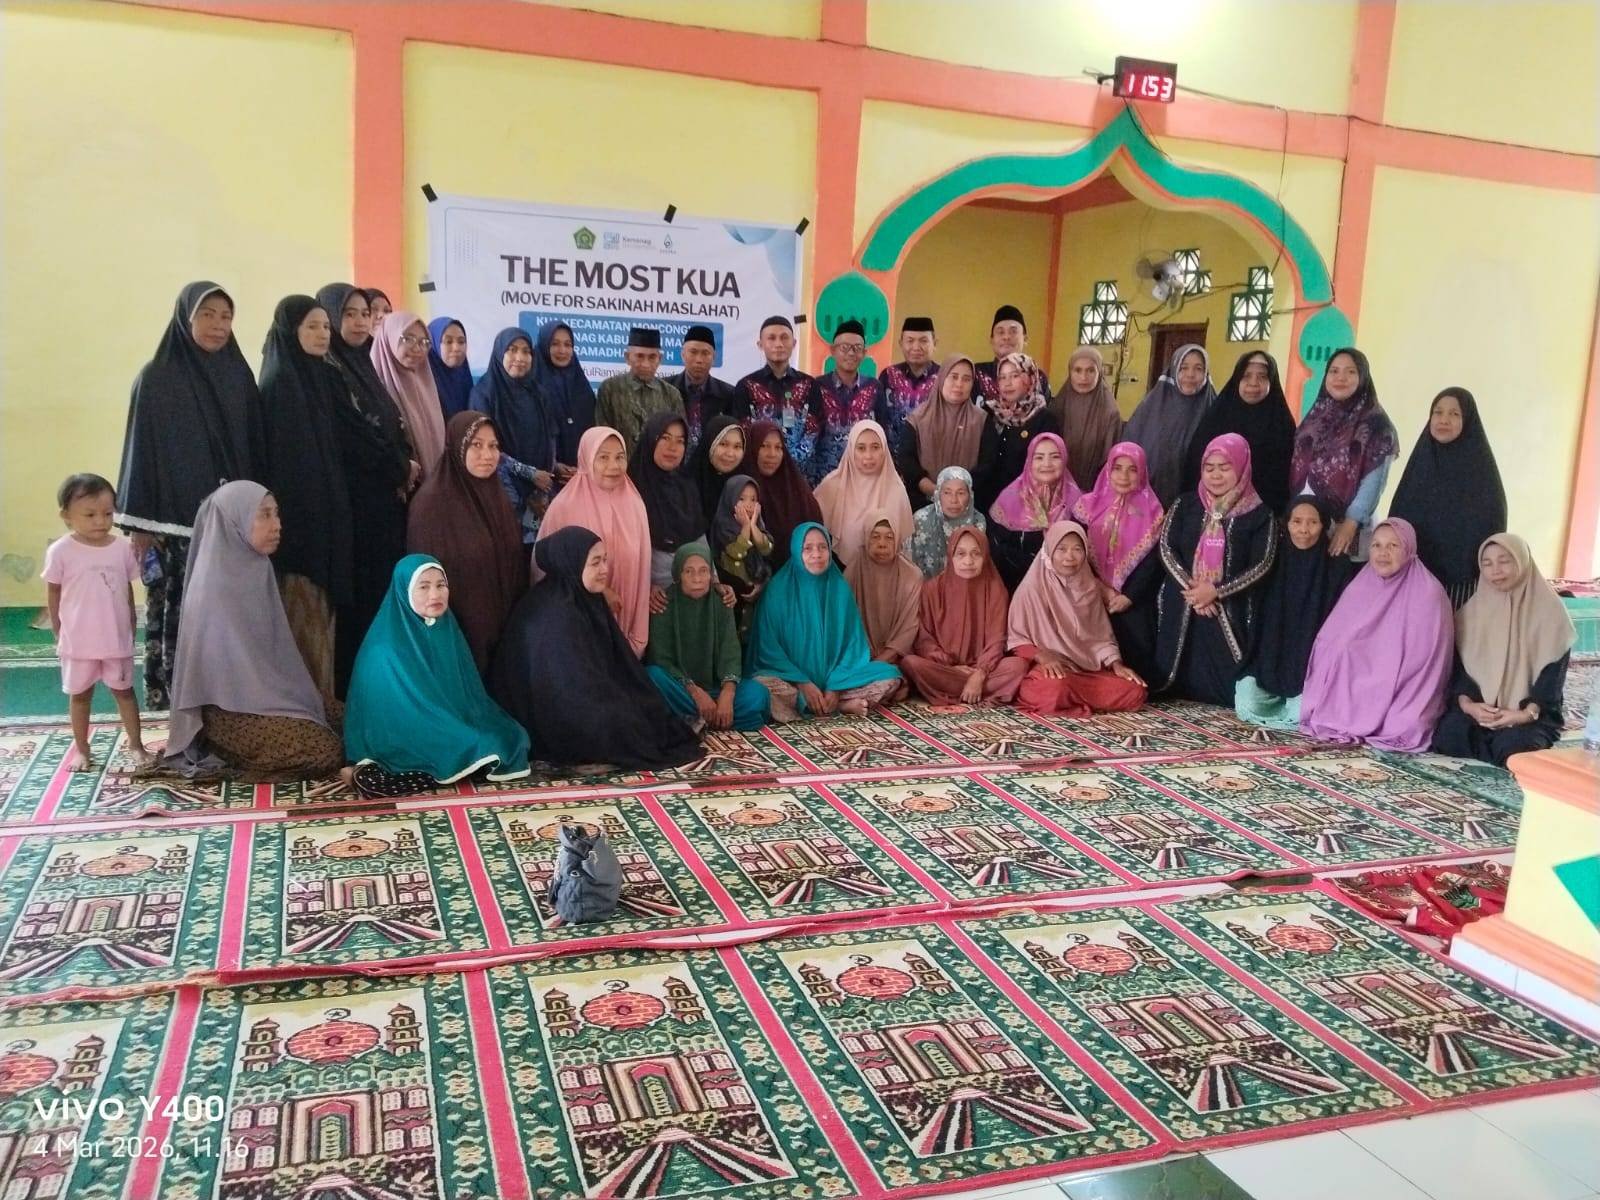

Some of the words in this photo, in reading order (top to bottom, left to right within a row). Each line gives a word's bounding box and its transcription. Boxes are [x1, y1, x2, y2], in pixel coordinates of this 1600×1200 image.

[500, 254, 569, 287] THE
[575, 260, 671, 294] MOST
[677, 268, 741, 299] KUA
[501, 290, 552, 307] (MOVE
[554, 293, 585, 308] FOR
[586, 296, 654, 313] SAKINAH
[656, 301, 740, 320] MASLAHAT)
